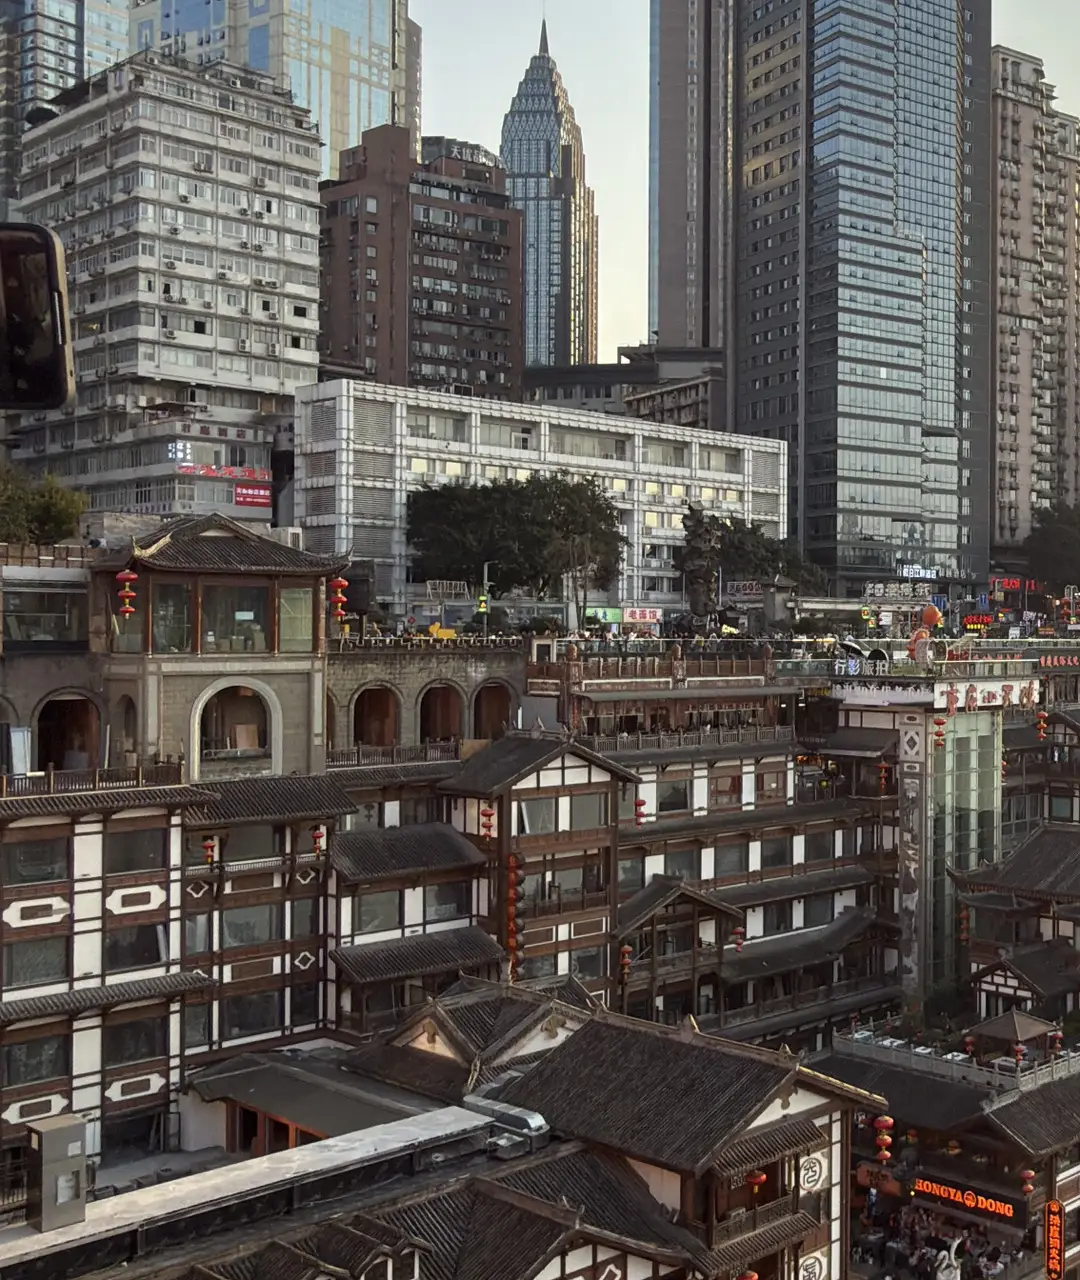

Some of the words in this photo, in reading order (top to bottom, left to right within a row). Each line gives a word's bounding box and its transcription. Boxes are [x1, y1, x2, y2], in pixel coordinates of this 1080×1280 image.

[914, 1178, 963, 1203] HONGYA
[977, 1195, 1014, 1218] DONG
[1048, 1214, 1061, 1272] 洪崖洞火锅
